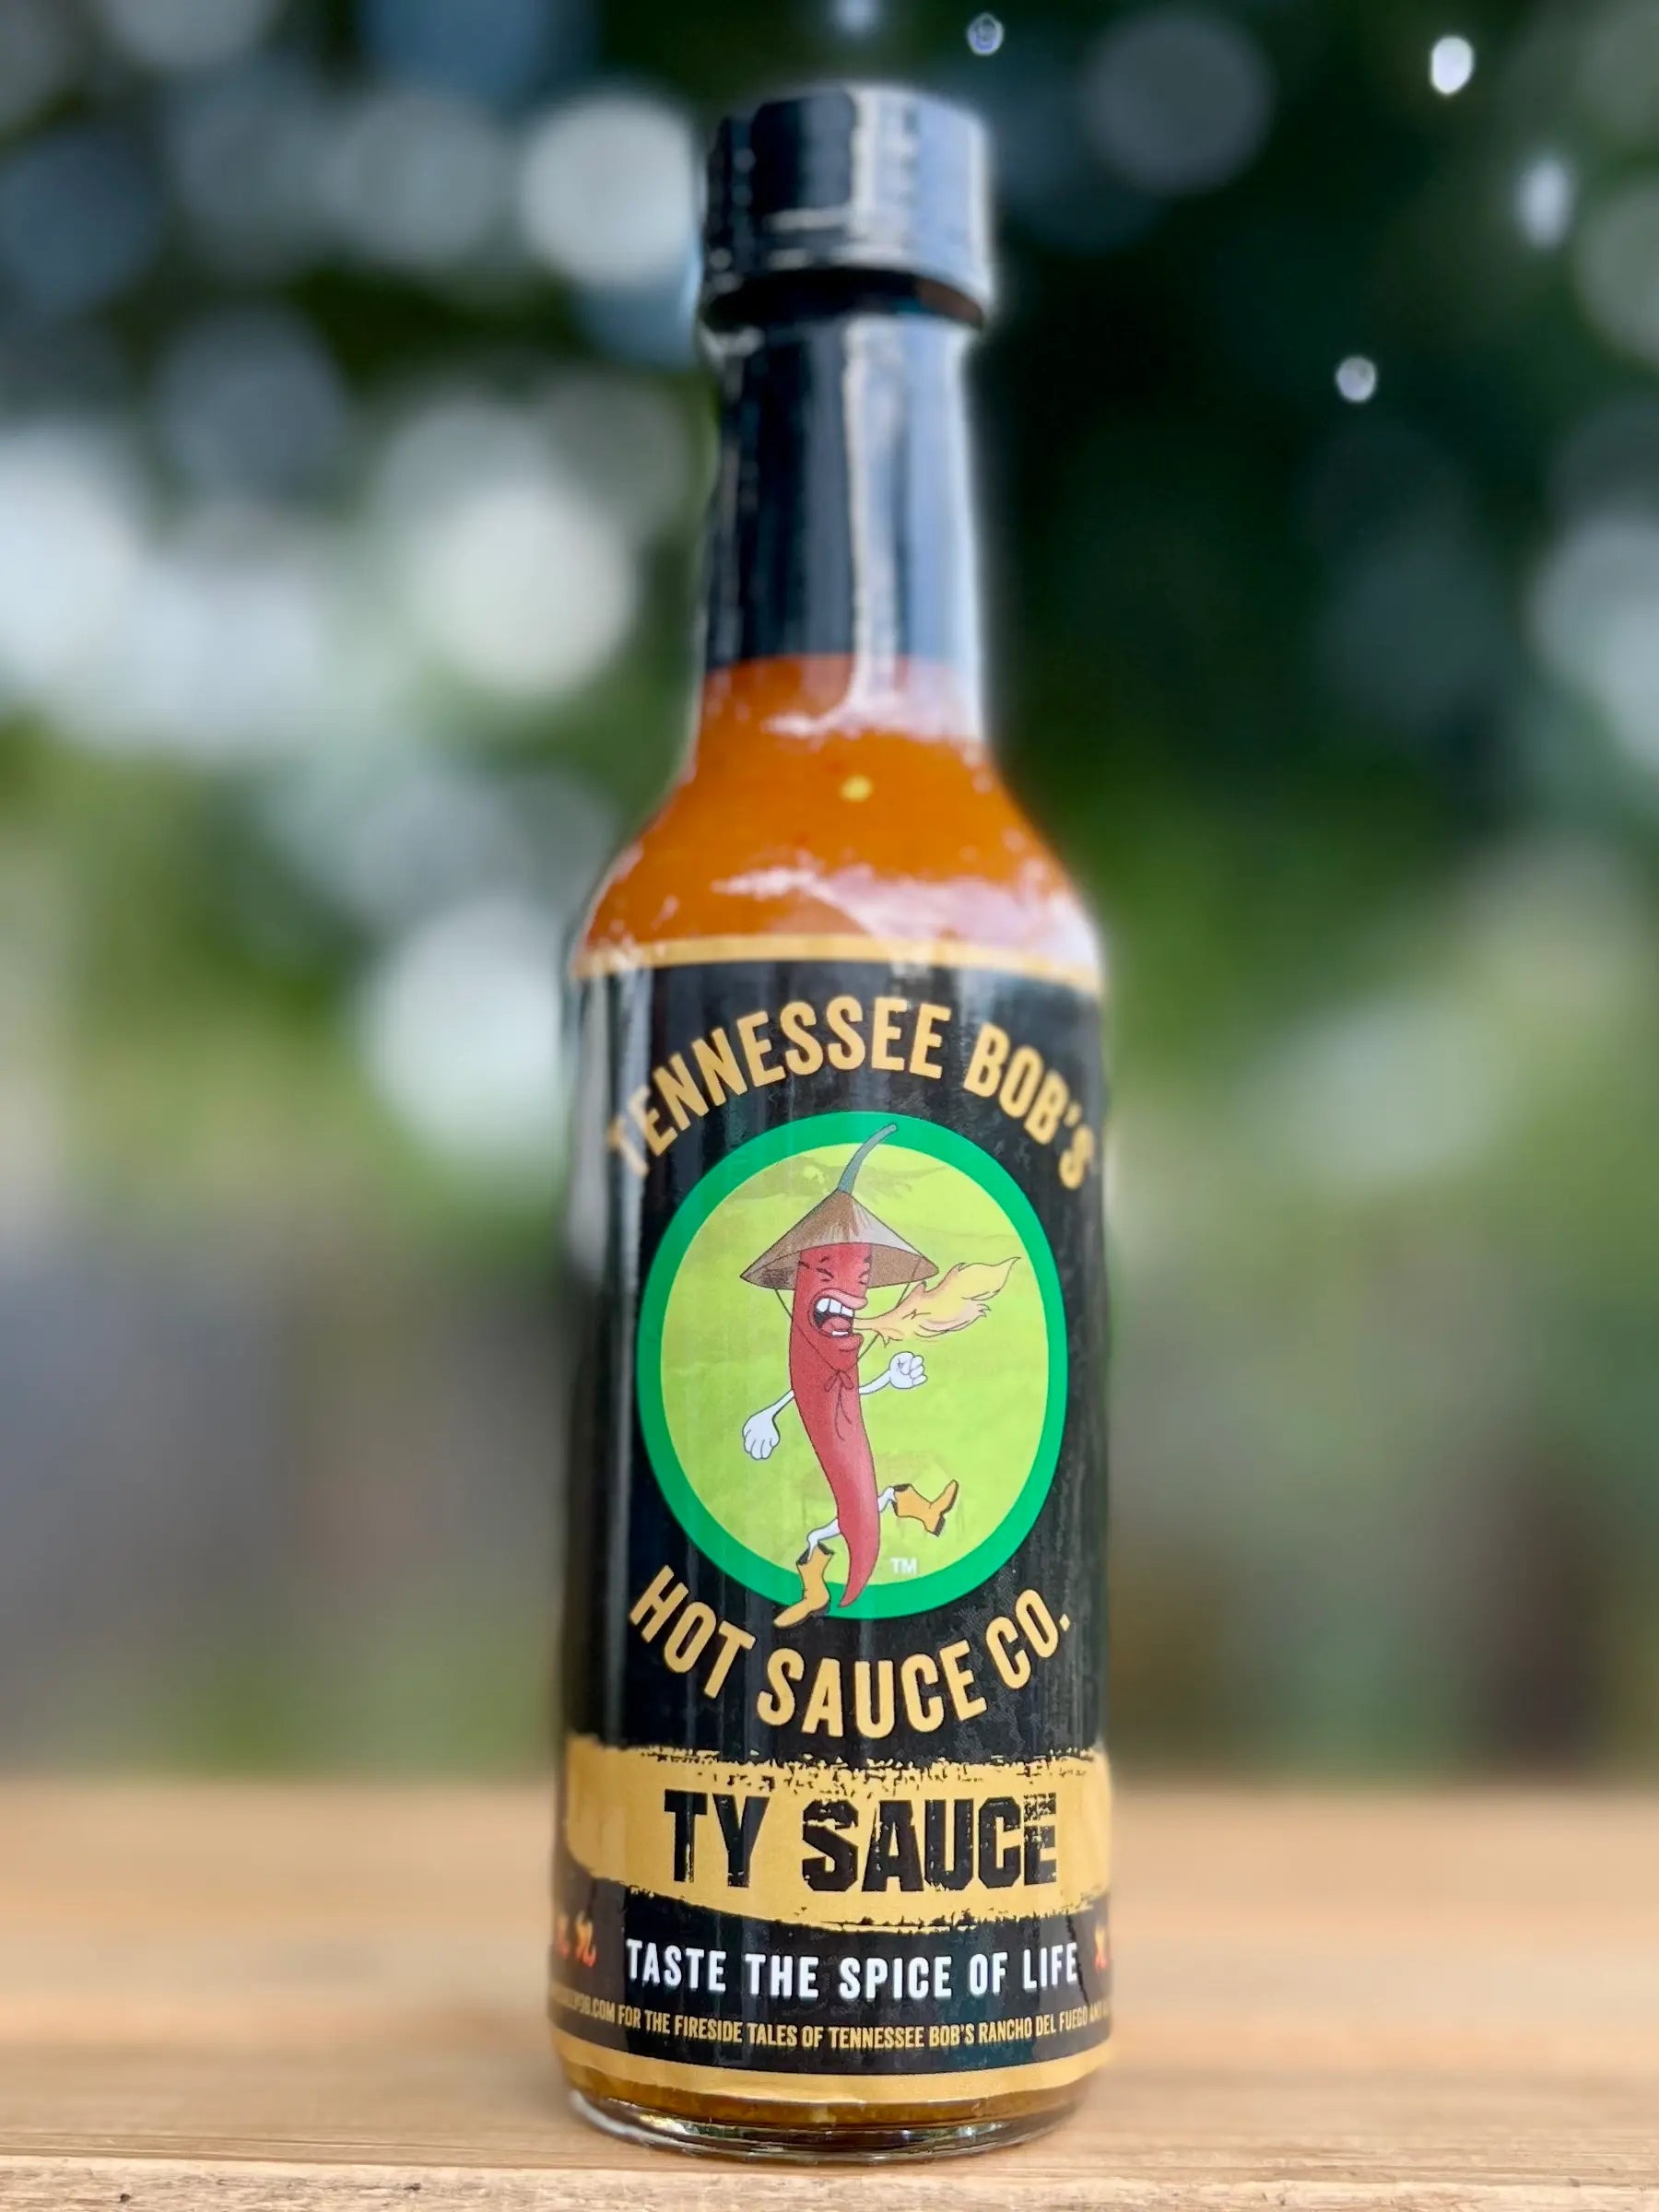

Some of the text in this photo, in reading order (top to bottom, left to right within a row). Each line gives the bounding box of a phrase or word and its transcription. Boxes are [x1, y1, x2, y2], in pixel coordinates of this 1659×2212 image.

[607, 996, 1095, 1190] TENNESSEE BOB'S
[890, 1557, 917, 1574] TM
[629, 1565, 1070, 1739] HOT SAUCE CO.
[664, 1789, 1057, 1892] TY SAUCE
[627, 1938, 1078, 2002] TASTE THE SPICE OF LIFE
[618, 2004, 641, 2029] FOR
[645, 2009, 671, 2034] THE
[675, 2015, 743, 2043] FIRESIDE
[747, 2022, 798, 2047] TALES
[802, 2026, 824, 2048] OF
[830, 2026, 924, 2049] TENNESSEE
[929, 2024, 974, 2047] BOB'S
[979, 2017, 1032, 2044] RANCHO
[1035, 2013, 1057, 2037] DEL
[1059, 2005, 1088, 2032] FUEGO
